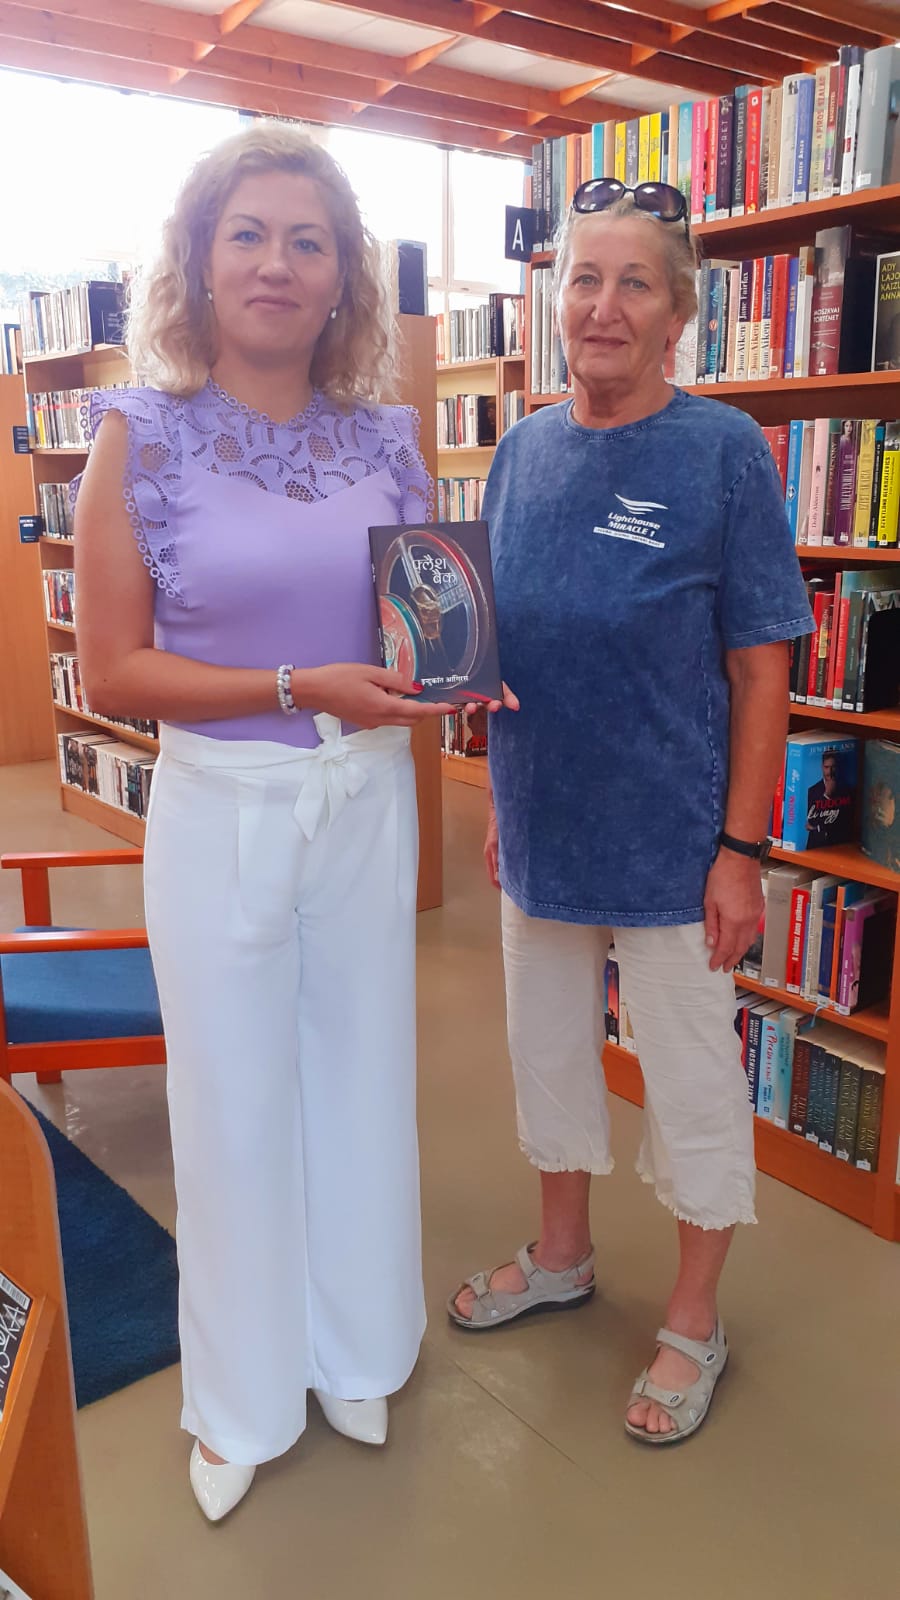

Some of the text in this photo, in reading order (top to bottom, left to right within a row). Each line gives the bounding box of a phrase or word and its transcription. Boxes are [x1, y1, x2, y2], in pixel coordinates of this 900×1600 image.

[720, 119, 728, 166] SECRET
[512, 219, 524, 251] A
[881, 263, 897, 272] ADY
[740, 271, 749, 320] Jane Fairfax
[737, 324, 747, 371] Joan Aiken
[761, 322, 771, 369] Joan Aiken
[607, 512, 661, 530] Lighthouse
[607, 521, 649, 535] MIRACLE
[431, 568, 457, 584] बैक
[748, 1047, 758, 1081] ATKINSON
